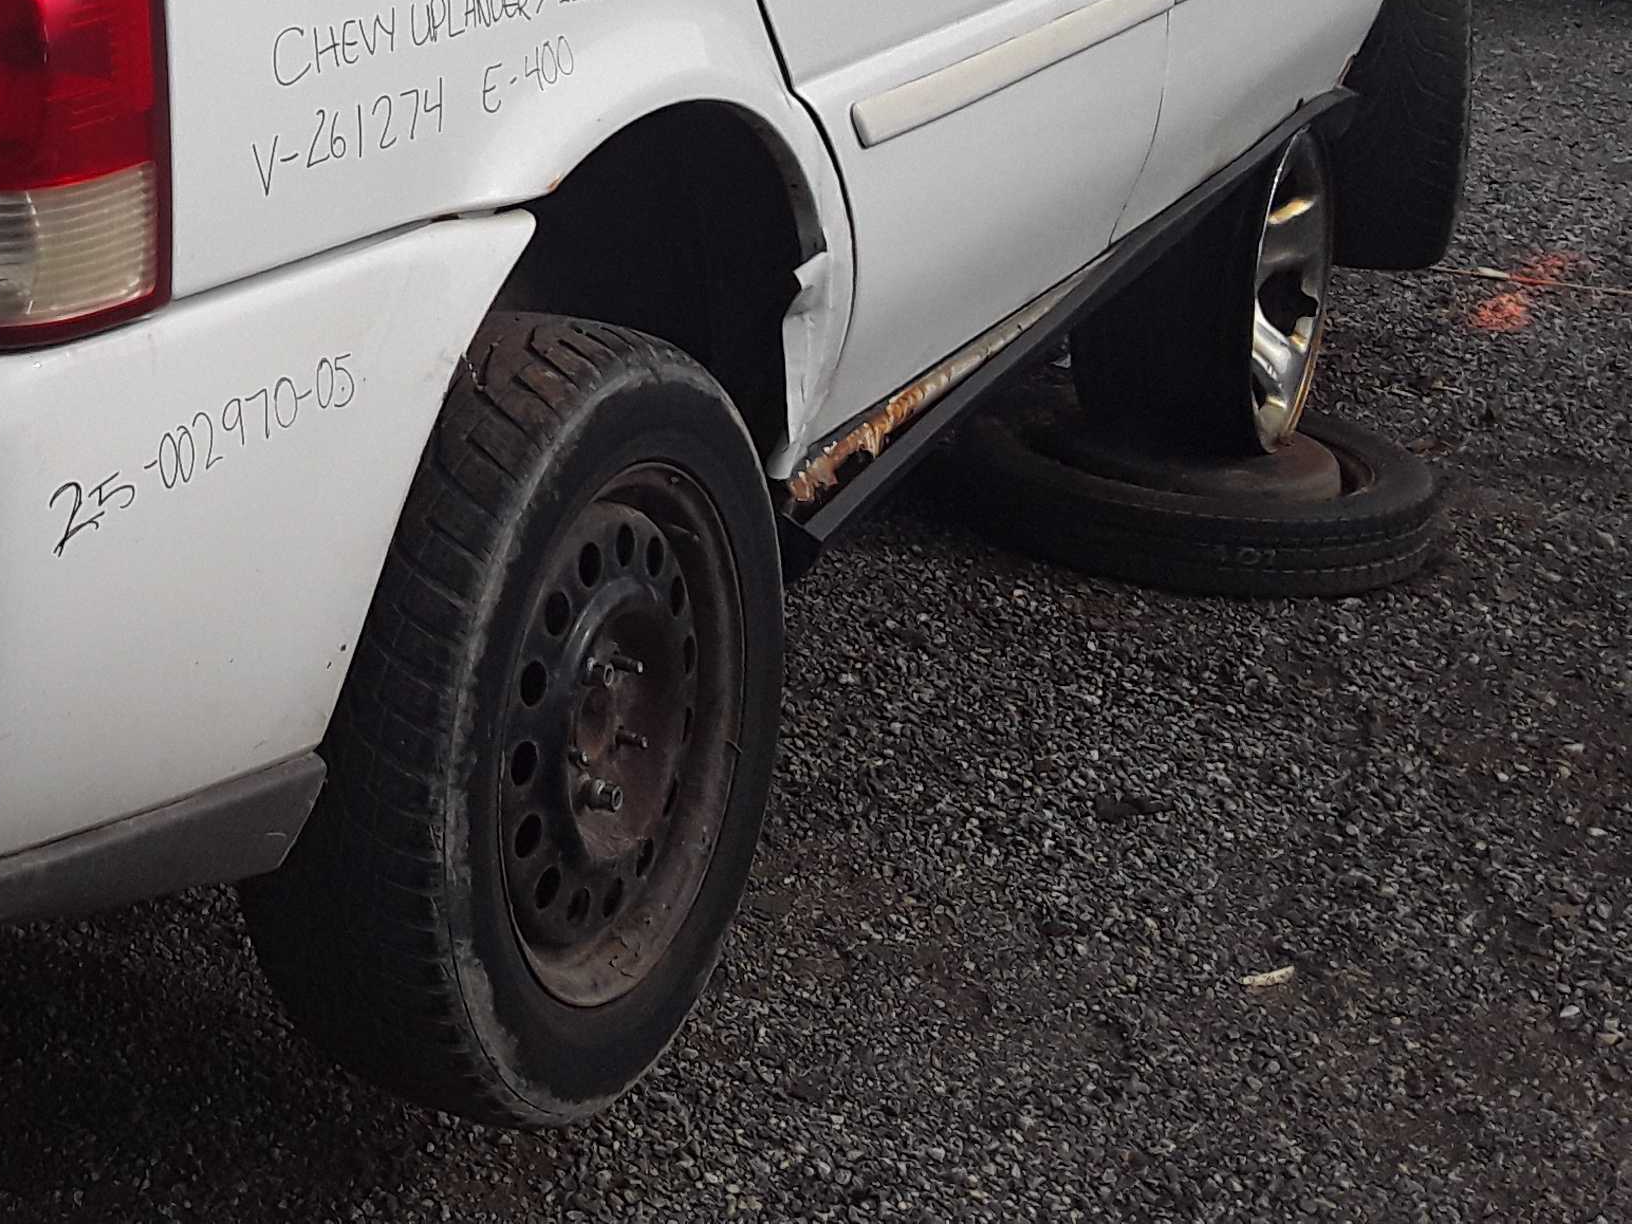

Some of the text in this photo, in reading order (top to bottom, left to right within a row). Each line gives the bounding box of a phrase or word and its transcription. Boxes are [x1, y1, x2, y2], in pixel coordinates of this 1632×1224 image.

[252, 35, 575, 196] V-261274 E-400
[273, 7, 396, 86] CHEVY
[49, 353, 355, 557] 25-002970-05
